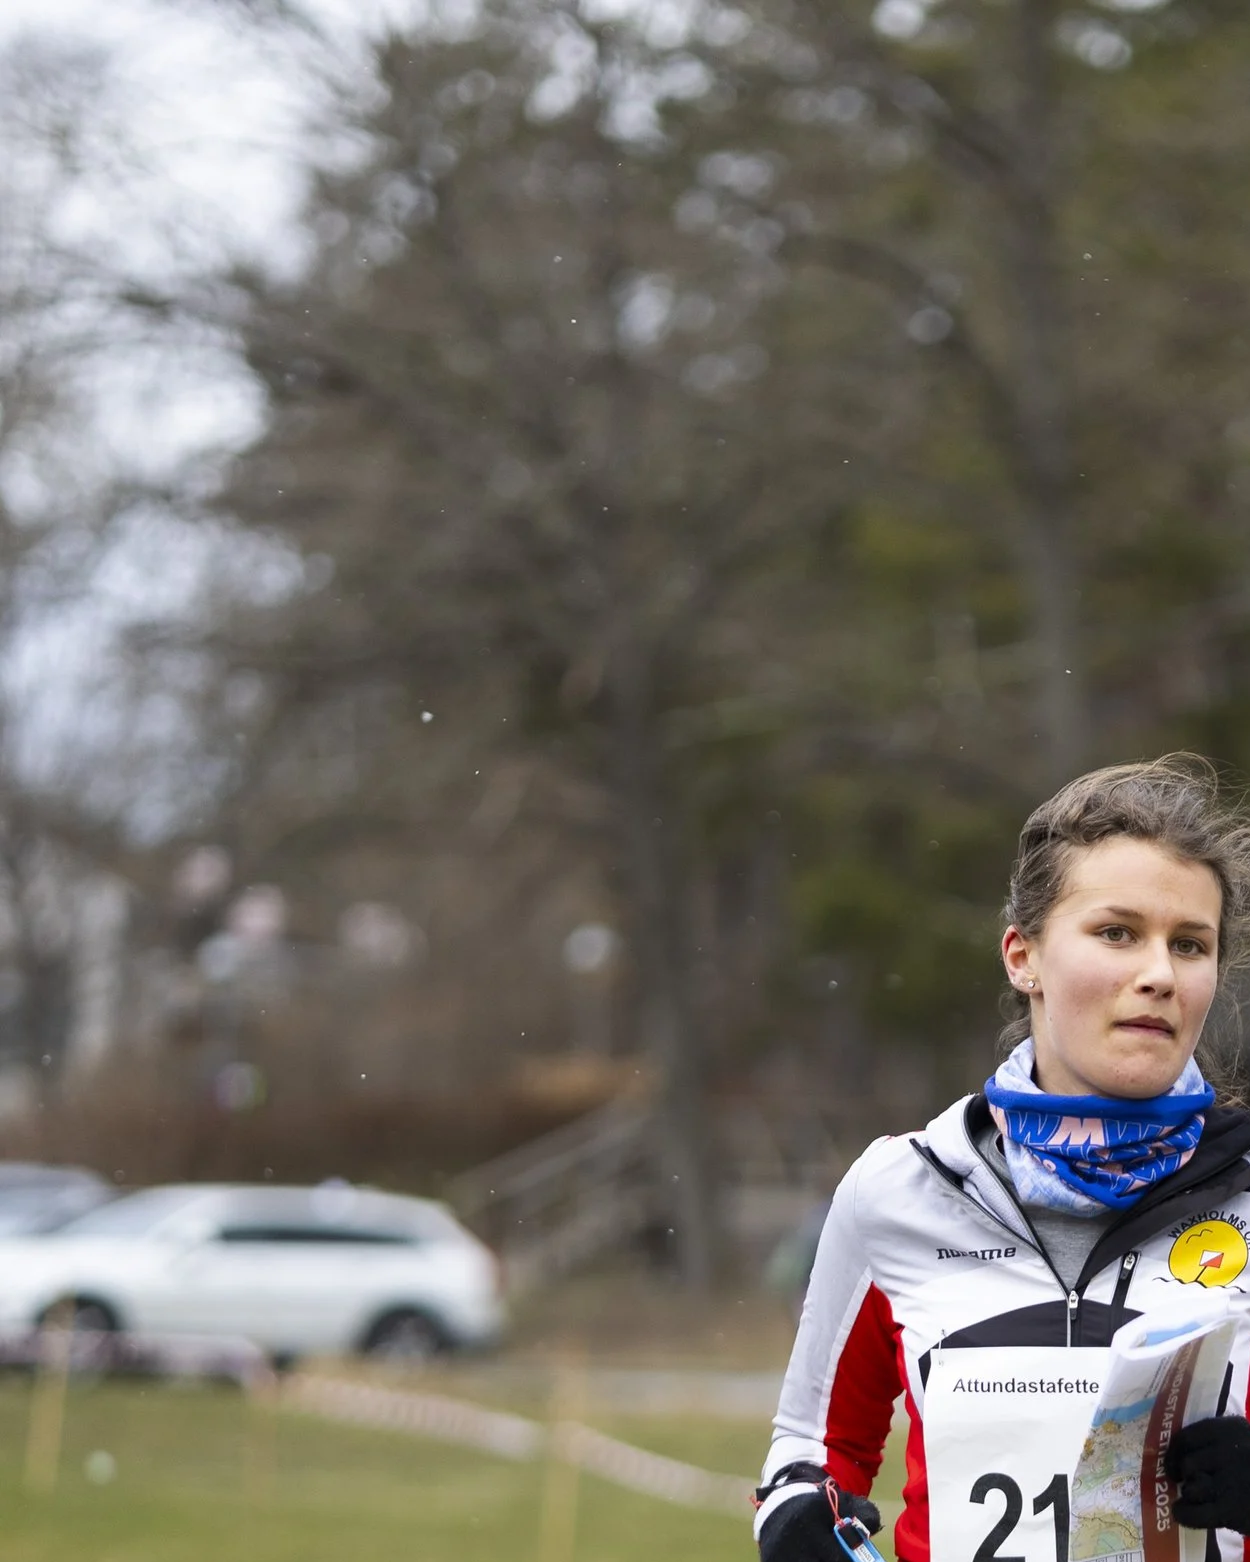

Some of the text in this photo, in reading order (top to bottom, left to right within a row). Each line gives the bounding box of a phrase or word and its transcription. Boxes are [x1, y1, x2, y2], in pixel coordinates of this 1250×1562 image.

[1168, 1210, 1247, 1239] WAXHOLMS
[952, 1377, 1100, 1394] Attundastafette
[1155, 1342, 1194, 1478] TTUNDASTAFETTEN
[1155, 1481, 1171, 1532] 2025
